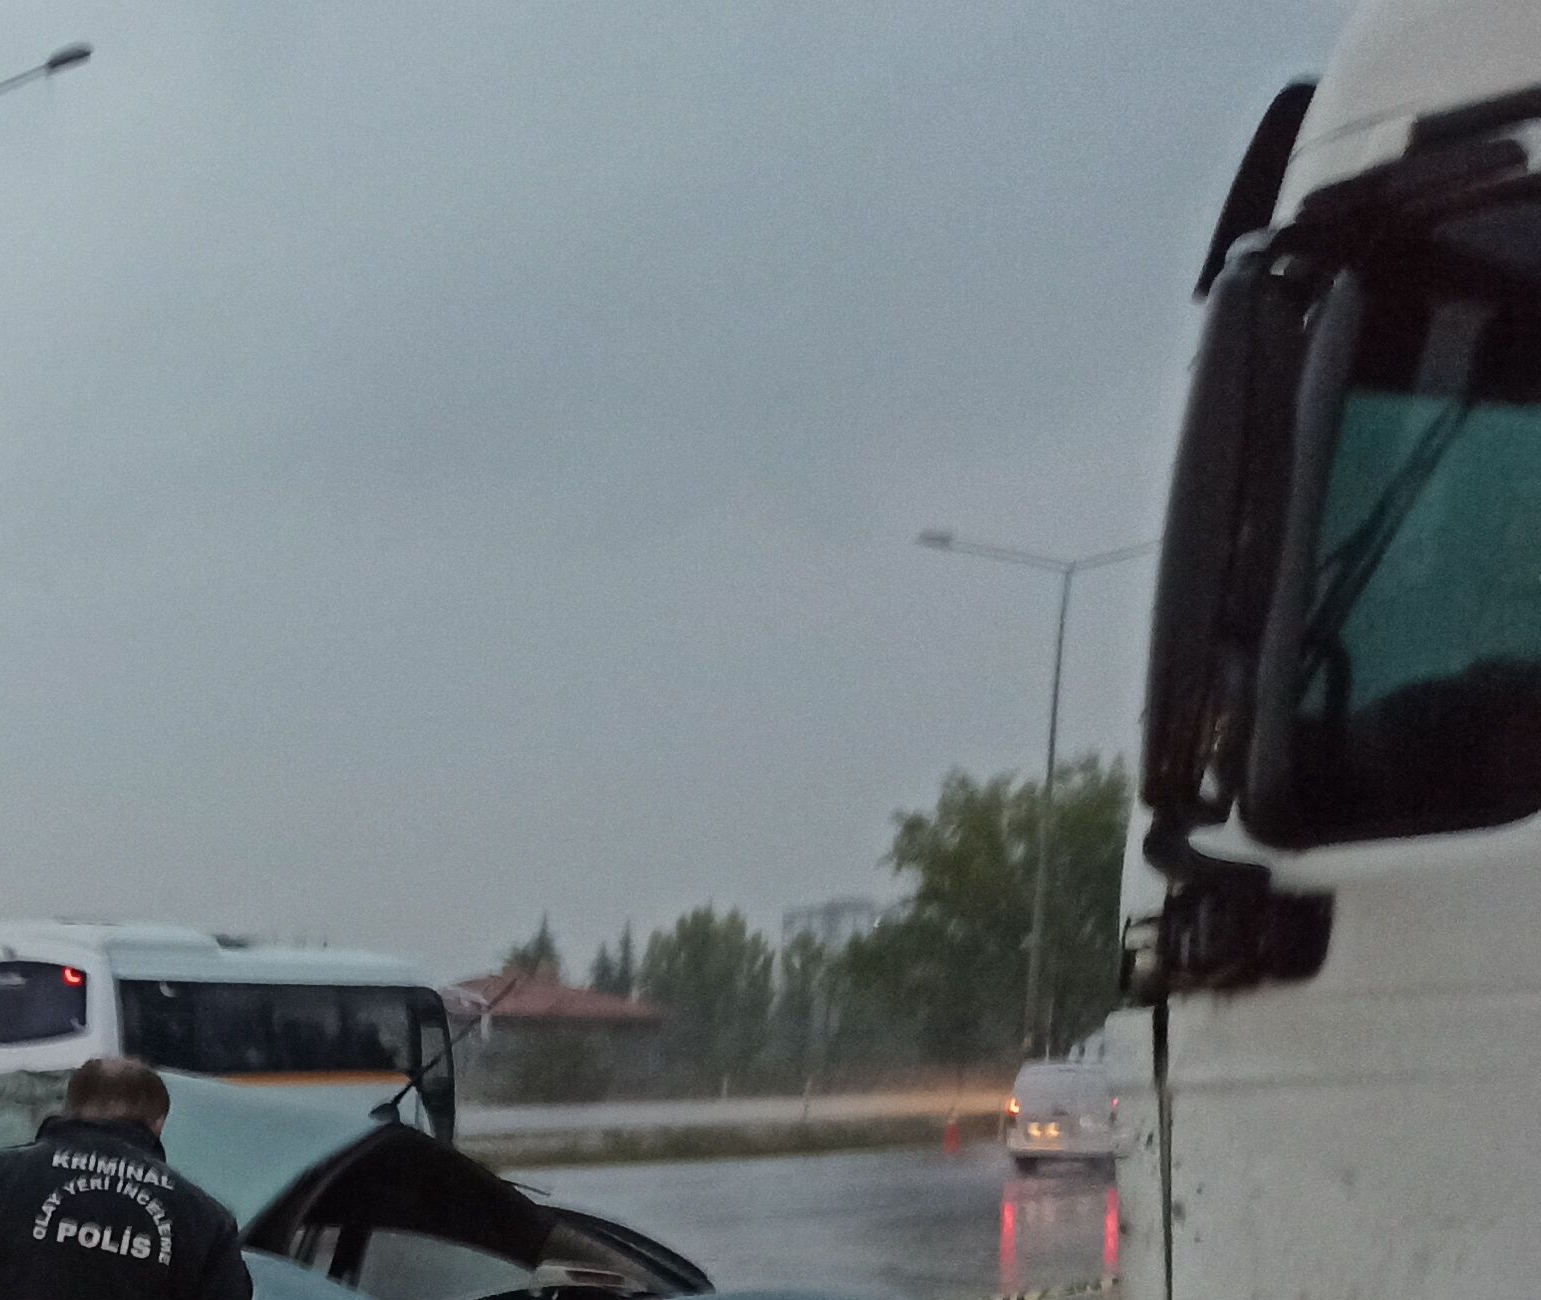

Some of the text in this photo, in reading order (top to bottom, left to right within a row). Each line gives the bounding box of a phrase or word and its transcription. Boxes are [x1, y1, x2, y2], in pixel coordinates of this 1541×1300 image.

[52, 1151, 175, 1190] KRİMİNAL
[33, 1189, 62, 1240] OLAY
[56, 1217, 152, 1259] POLİS
